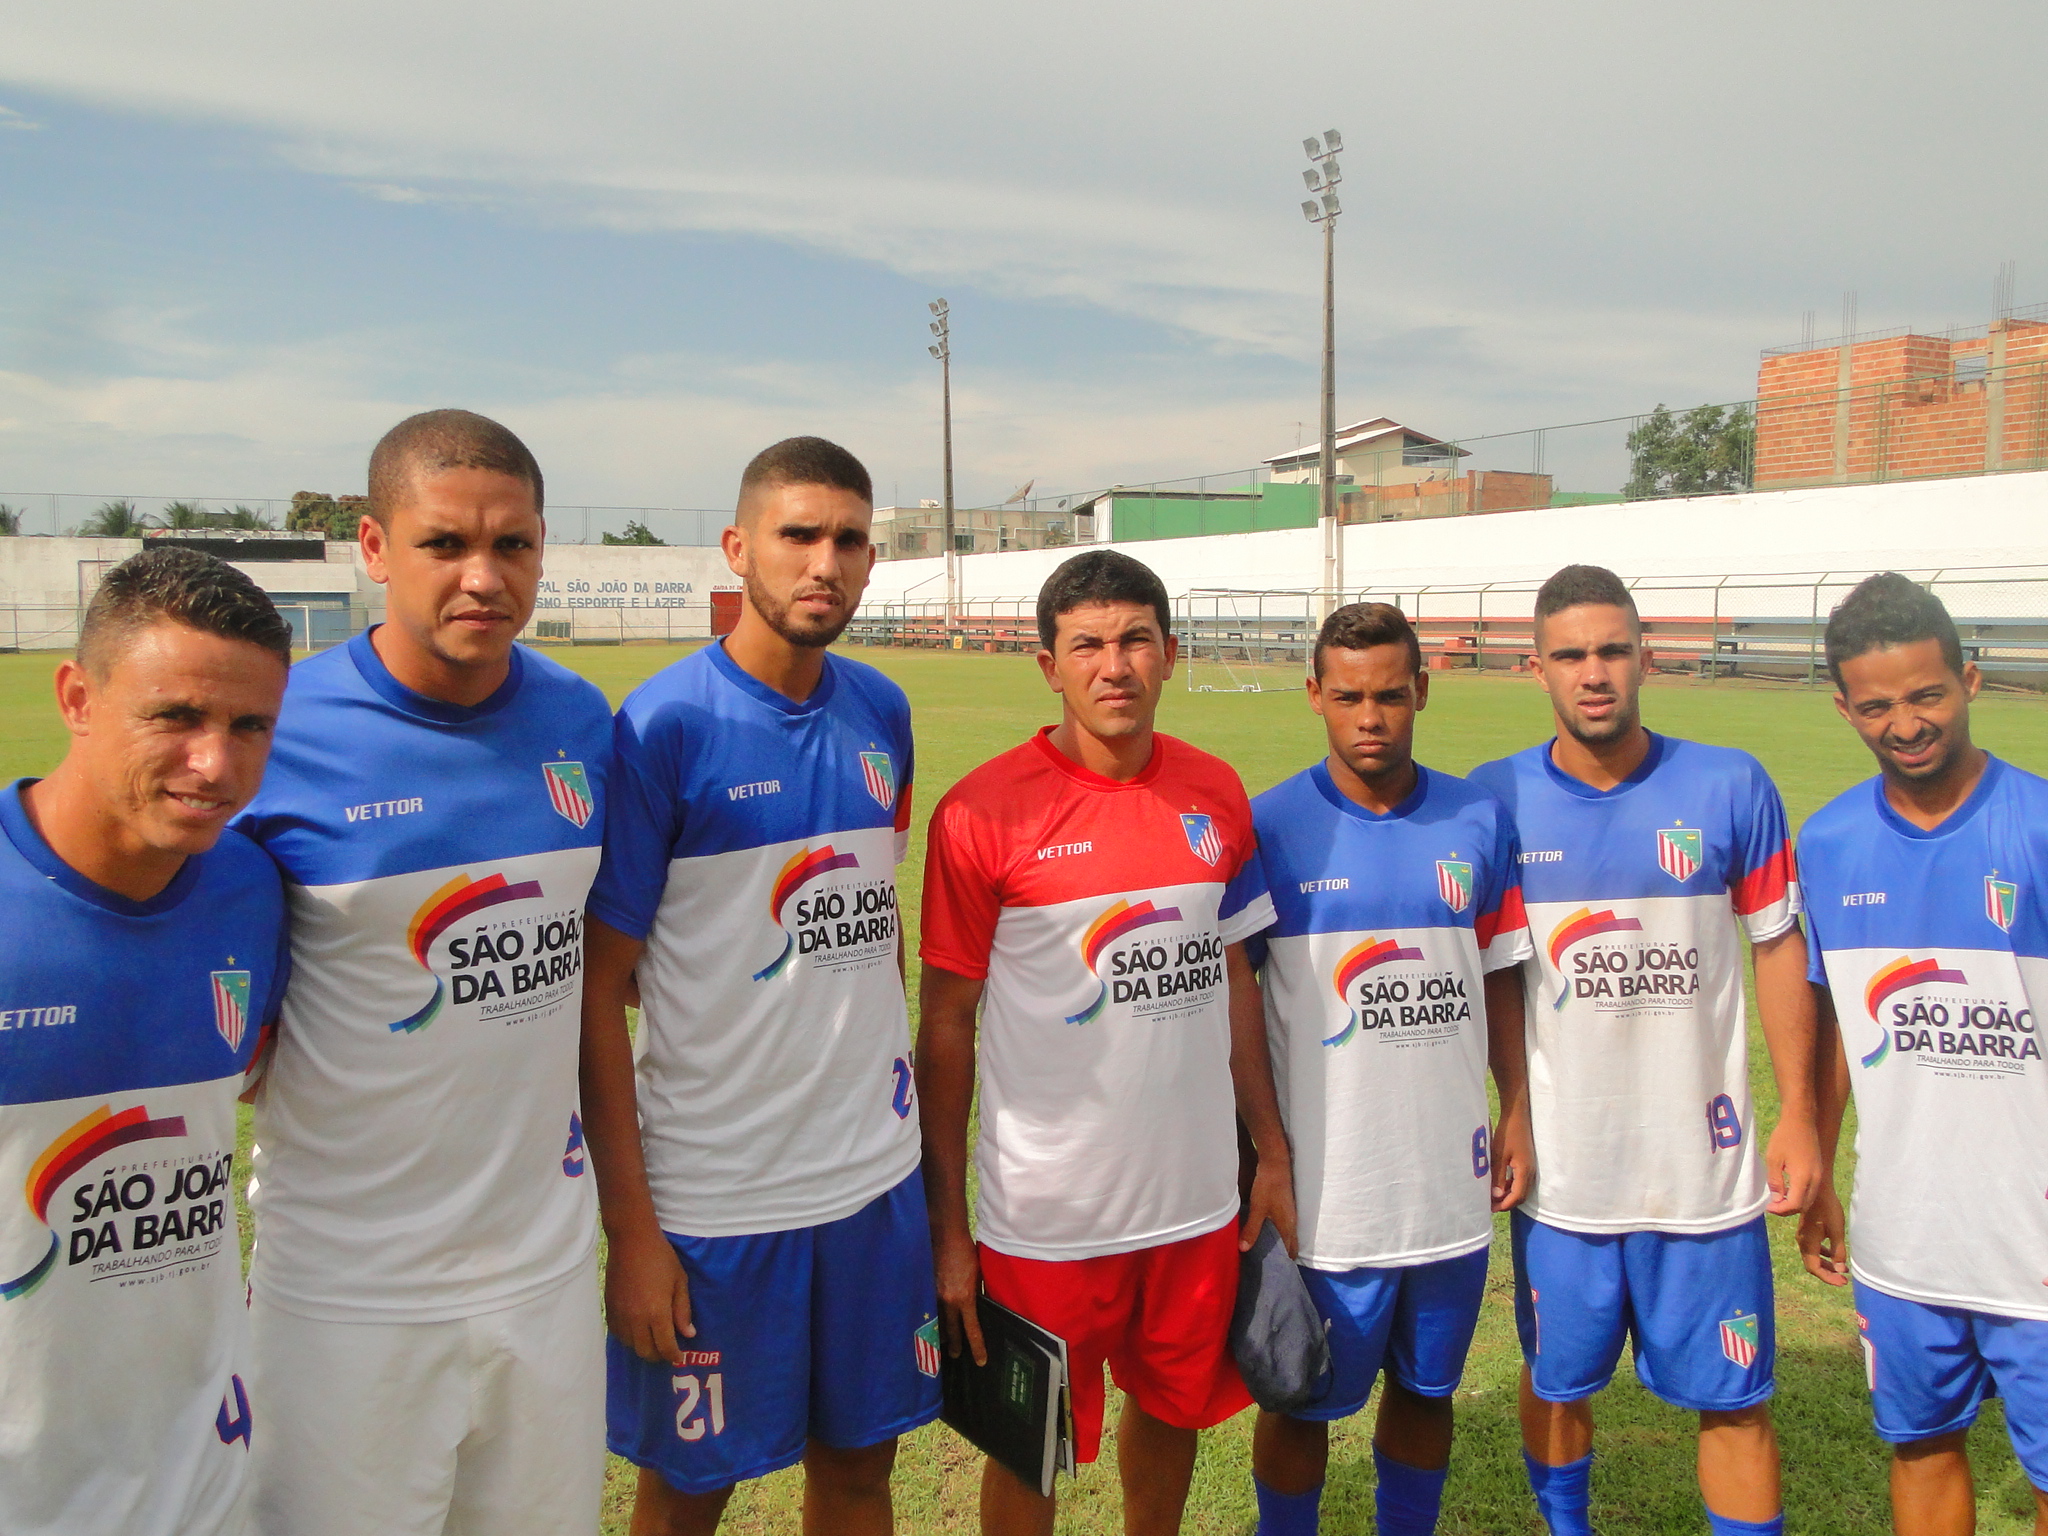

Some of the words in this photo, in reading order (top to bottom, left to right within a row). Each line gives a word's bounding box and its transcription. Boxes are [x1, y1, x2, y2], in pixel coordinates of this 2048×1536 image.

[567, 579, 590, 593] SÃO
[597, 579, 628, 593] JOÃO
[634, 582, 649, 593] DA
[655, 582, 693, 593] BARRA
[567, 597, 625, 608] ESPORTE
[631, 598, 640, 608] E
[646, 598, 686, 608] LAZER
[728, 779, 781, 801] VETTOR
[345, 797, 423, 823] VETTOR
[1037, 841, 1092, 861] VETTOR
[1516, 850, 1563, 864] VETTOR
[1299, 878, 1349, 894] VETTOR
[797, 888, 845, 926] SÃO
[853, 879, 895, 916] JOÃO
[493, 911, 565, 930] PREFEITURA
[799, 926, 832, 954] DA
[836, 914, 895, 947] BARRA
[449, 925, 524, 970] SÃO
[814, 948, 863, 963] TRABALHANDO
[1112, 941, 1167, 976] SÃO
[1174, 931, 1223, 967] JOÃO
[1573, 945, 1628, 974] SÃO
[1635, 942, 1699, 972] JOÃO
[1604, 942, 1665, 950] PREFEITURA
[452, 970, 506, 1005] DA
[512, 946, 581, 995] BARRA
[1113, 977, 1152, 1004] DA
[1157, 963, 1222, 998] BARRA
[1360, 975, 1409, 1005] SÃO
[1575, 977, 1614, 999] DA
[1618, 973, 1700, 998] BARRA
[480, 993, 544, 1015] TRABALHANDO
[1133, 998, 1183, 1013] TRABALHANDO
[1362, 1007, 1396, 1030] DA
[1400, 1001, 1471, 1027] BARRA
[1595, 998, 1647, 1008] TRABALHANDO
[1648, 997, 1666, 1005] PARA
[1668, 998, 1693, 1006] TODOS
[1892, 996, 1949, 1027] SÃO
[1958, 1001, 2035, 1033] JOÃO
[1380, 1029, 1426, 1039] TRABALHANDO
[1427, 1027, 1442, 1036] PARA
[1894, 1029, 1934, 1053] DA
[1938, 1031, 2042, 1060] BARRA
[1917, 1054, 1971, 1067] TRABALHANDO
[1973, 1060, 1994, 1068] PARA
[1997, 1060, 2025, 1071] TODOS
[1705, 1093, 1742, 1154] 19
[121, 1153, 212, 1174] PREFEITURA
[1472, 1124, 1489, 1179] 8
[72, 1167, 155, 1223] SÃO
[69, 1220, 123, 1266] DA
[92, 1249, 172, 1275] TRABALHANDO
[174, 1245, 200, 1258] PARA
[215, 1373, 253, 1453] 4
[672, 1372, 724, 1441] 21
